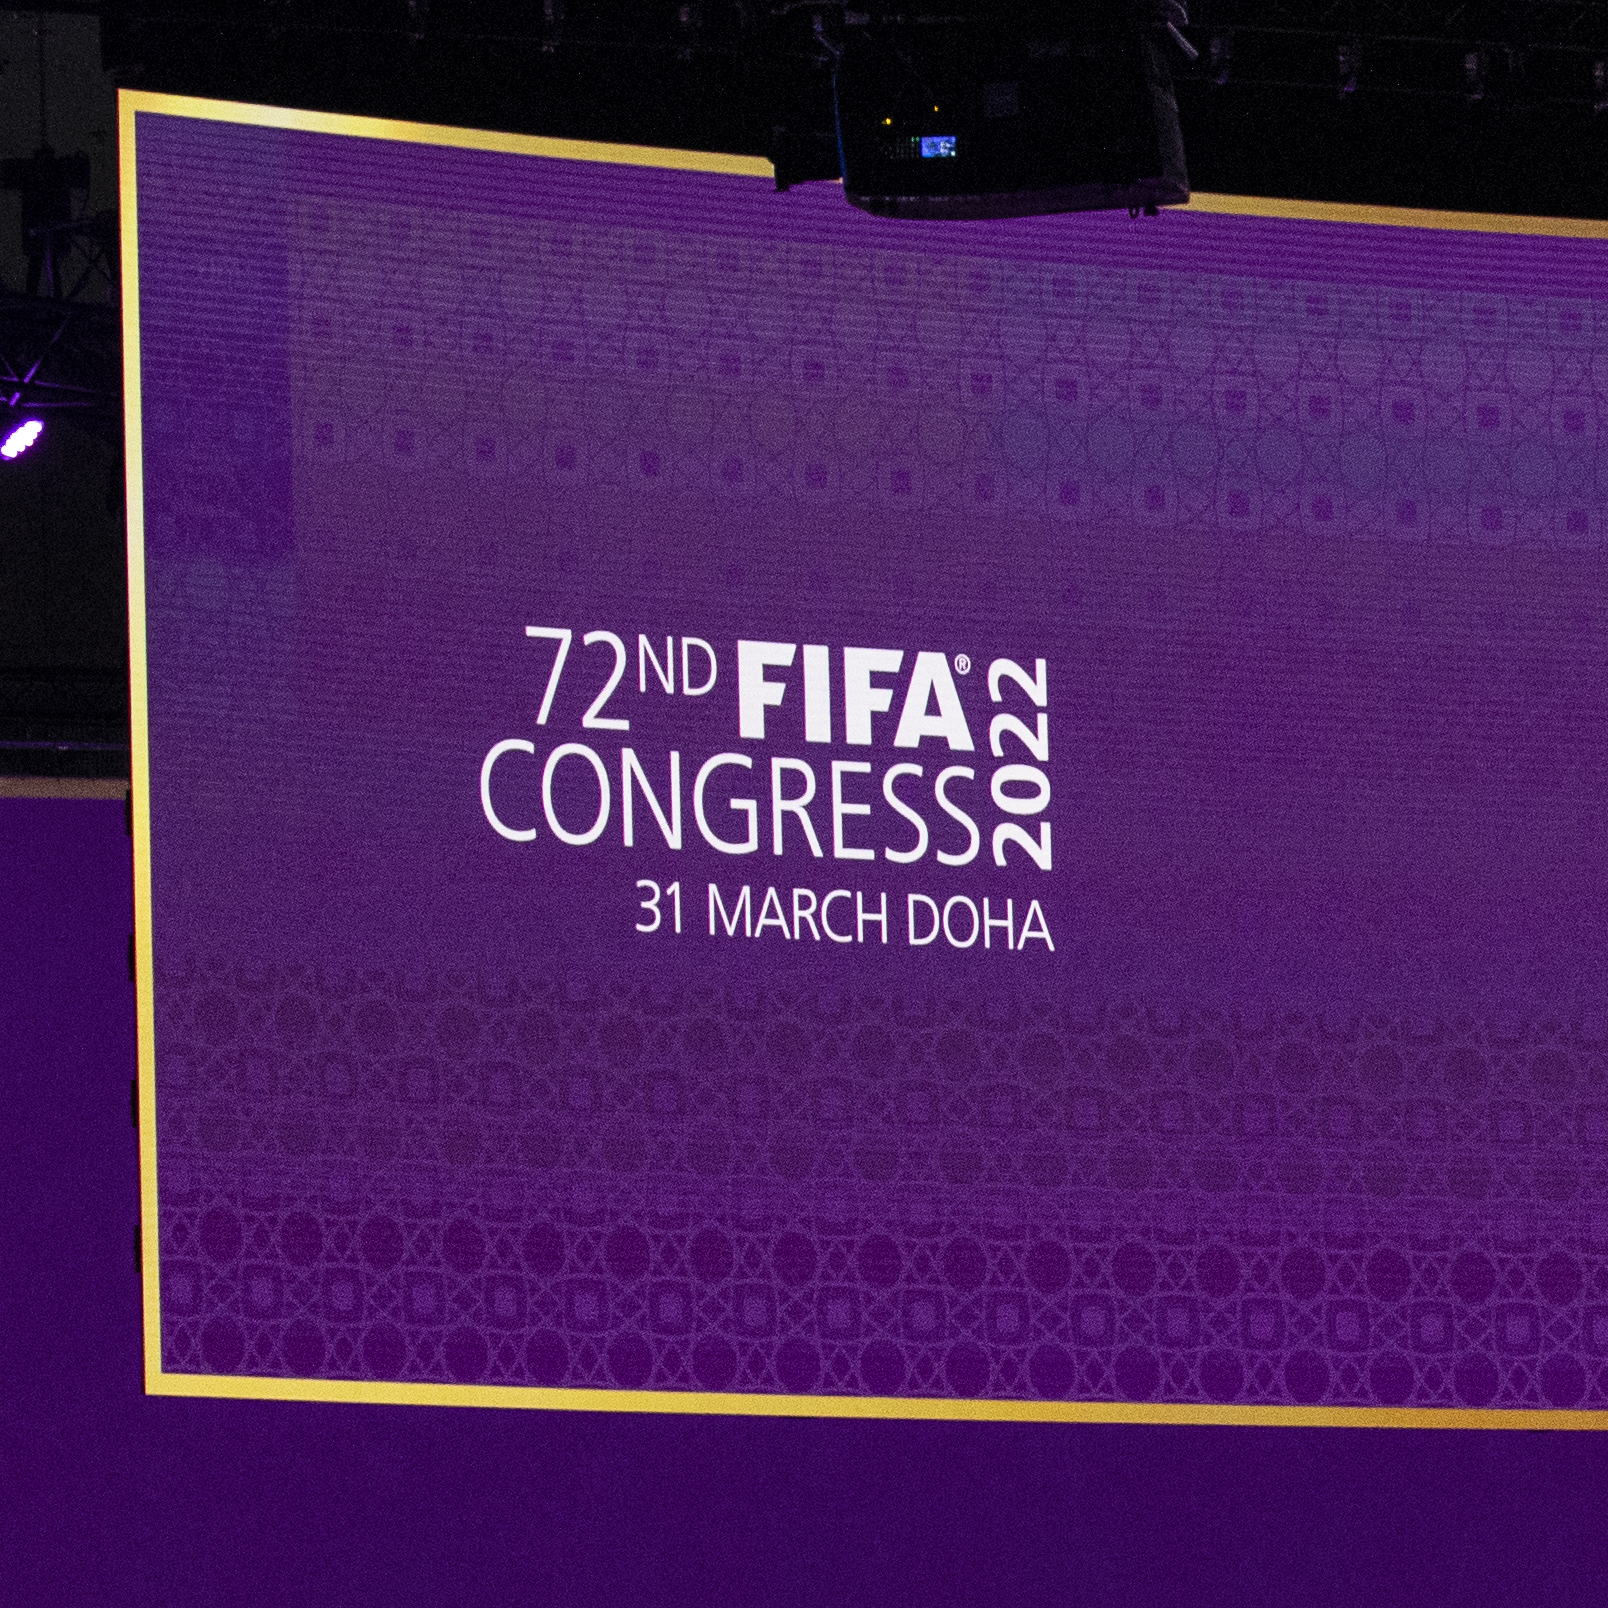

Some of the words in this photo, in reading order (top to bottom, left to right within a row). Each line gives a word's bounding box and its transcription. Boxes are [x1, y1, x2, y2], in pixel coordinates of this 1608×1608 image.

[525, 625, 718, 731] 72ND
[480, 738, 982, 867] CONGRESS
[986, 657, 1054, 871] 2022
[635, 879, 682, 934] 31
[707, 883, 888, 944] MARCH
[906, 892, 1056, 952] DOHA
